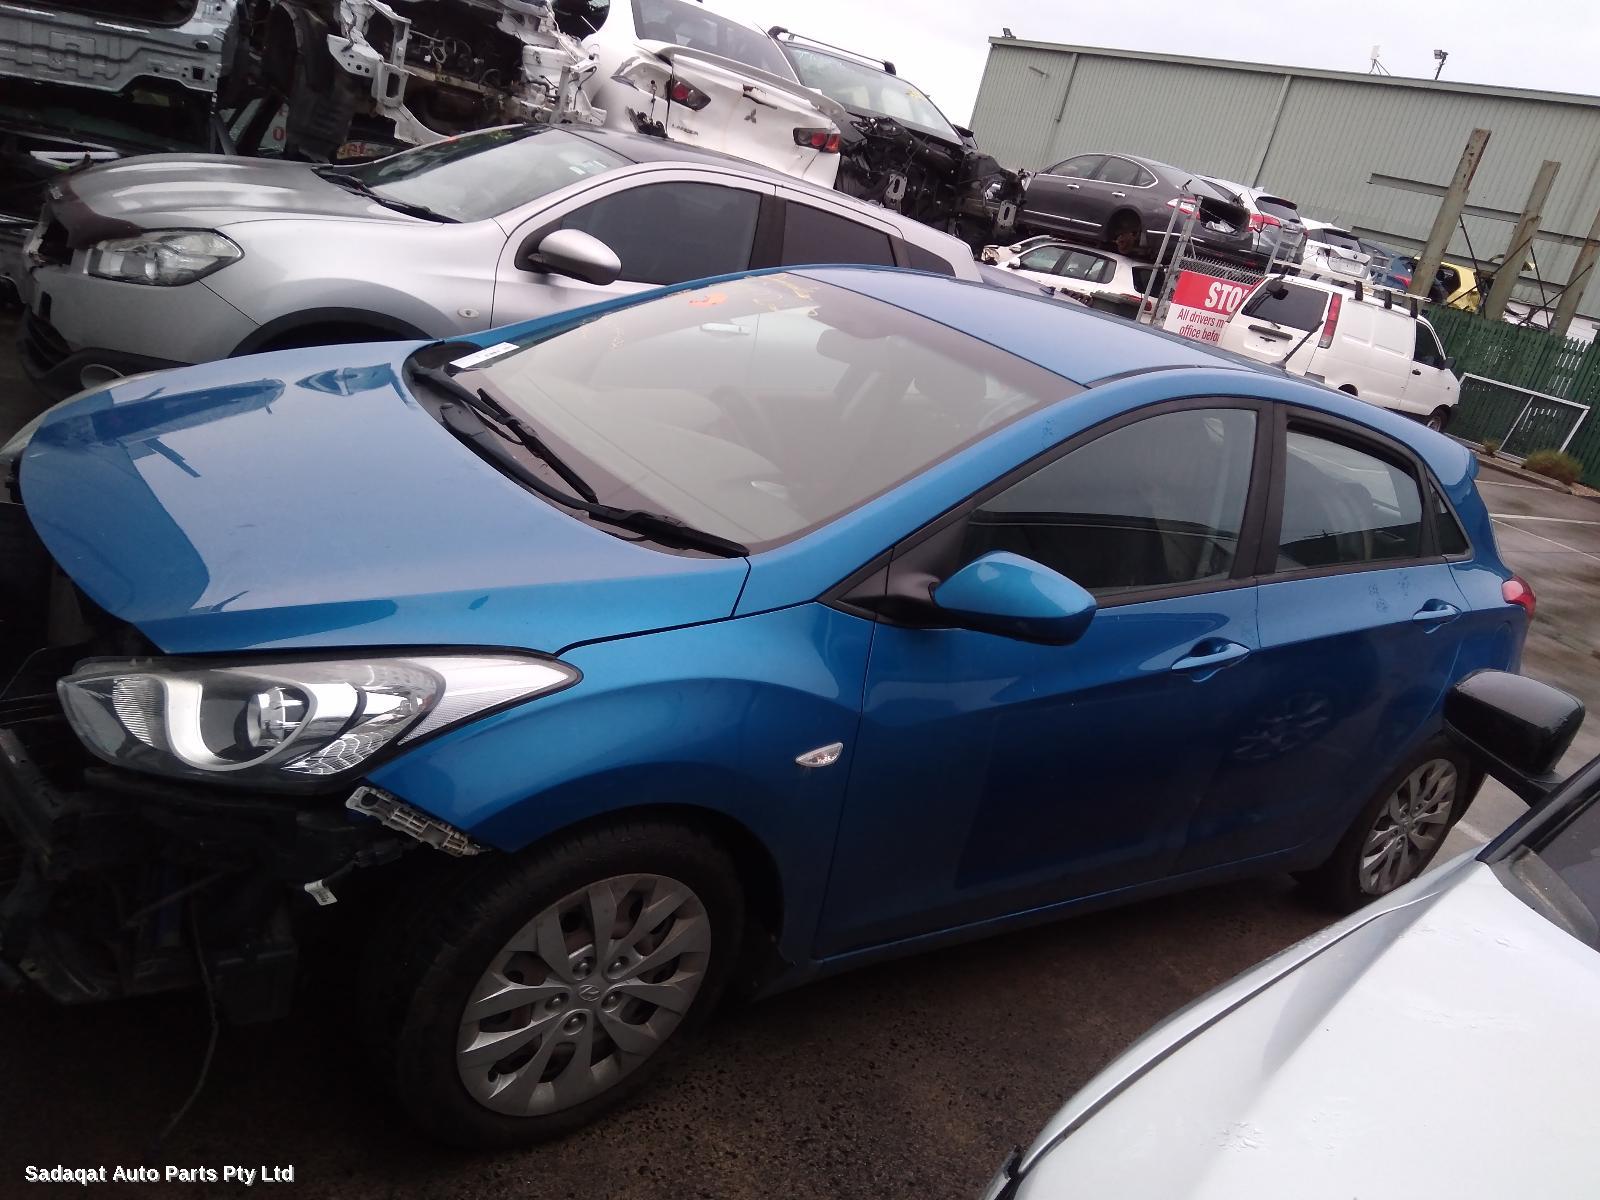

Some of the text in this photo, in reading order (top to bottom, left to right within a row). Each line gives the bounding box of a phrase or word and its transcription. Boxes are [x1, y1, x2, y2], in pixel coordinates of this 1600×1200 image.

[1177, 308, 1190, 320] All
[1189, 312, 1216, 327] drivers
[1179, 324, 1201, 339] office
